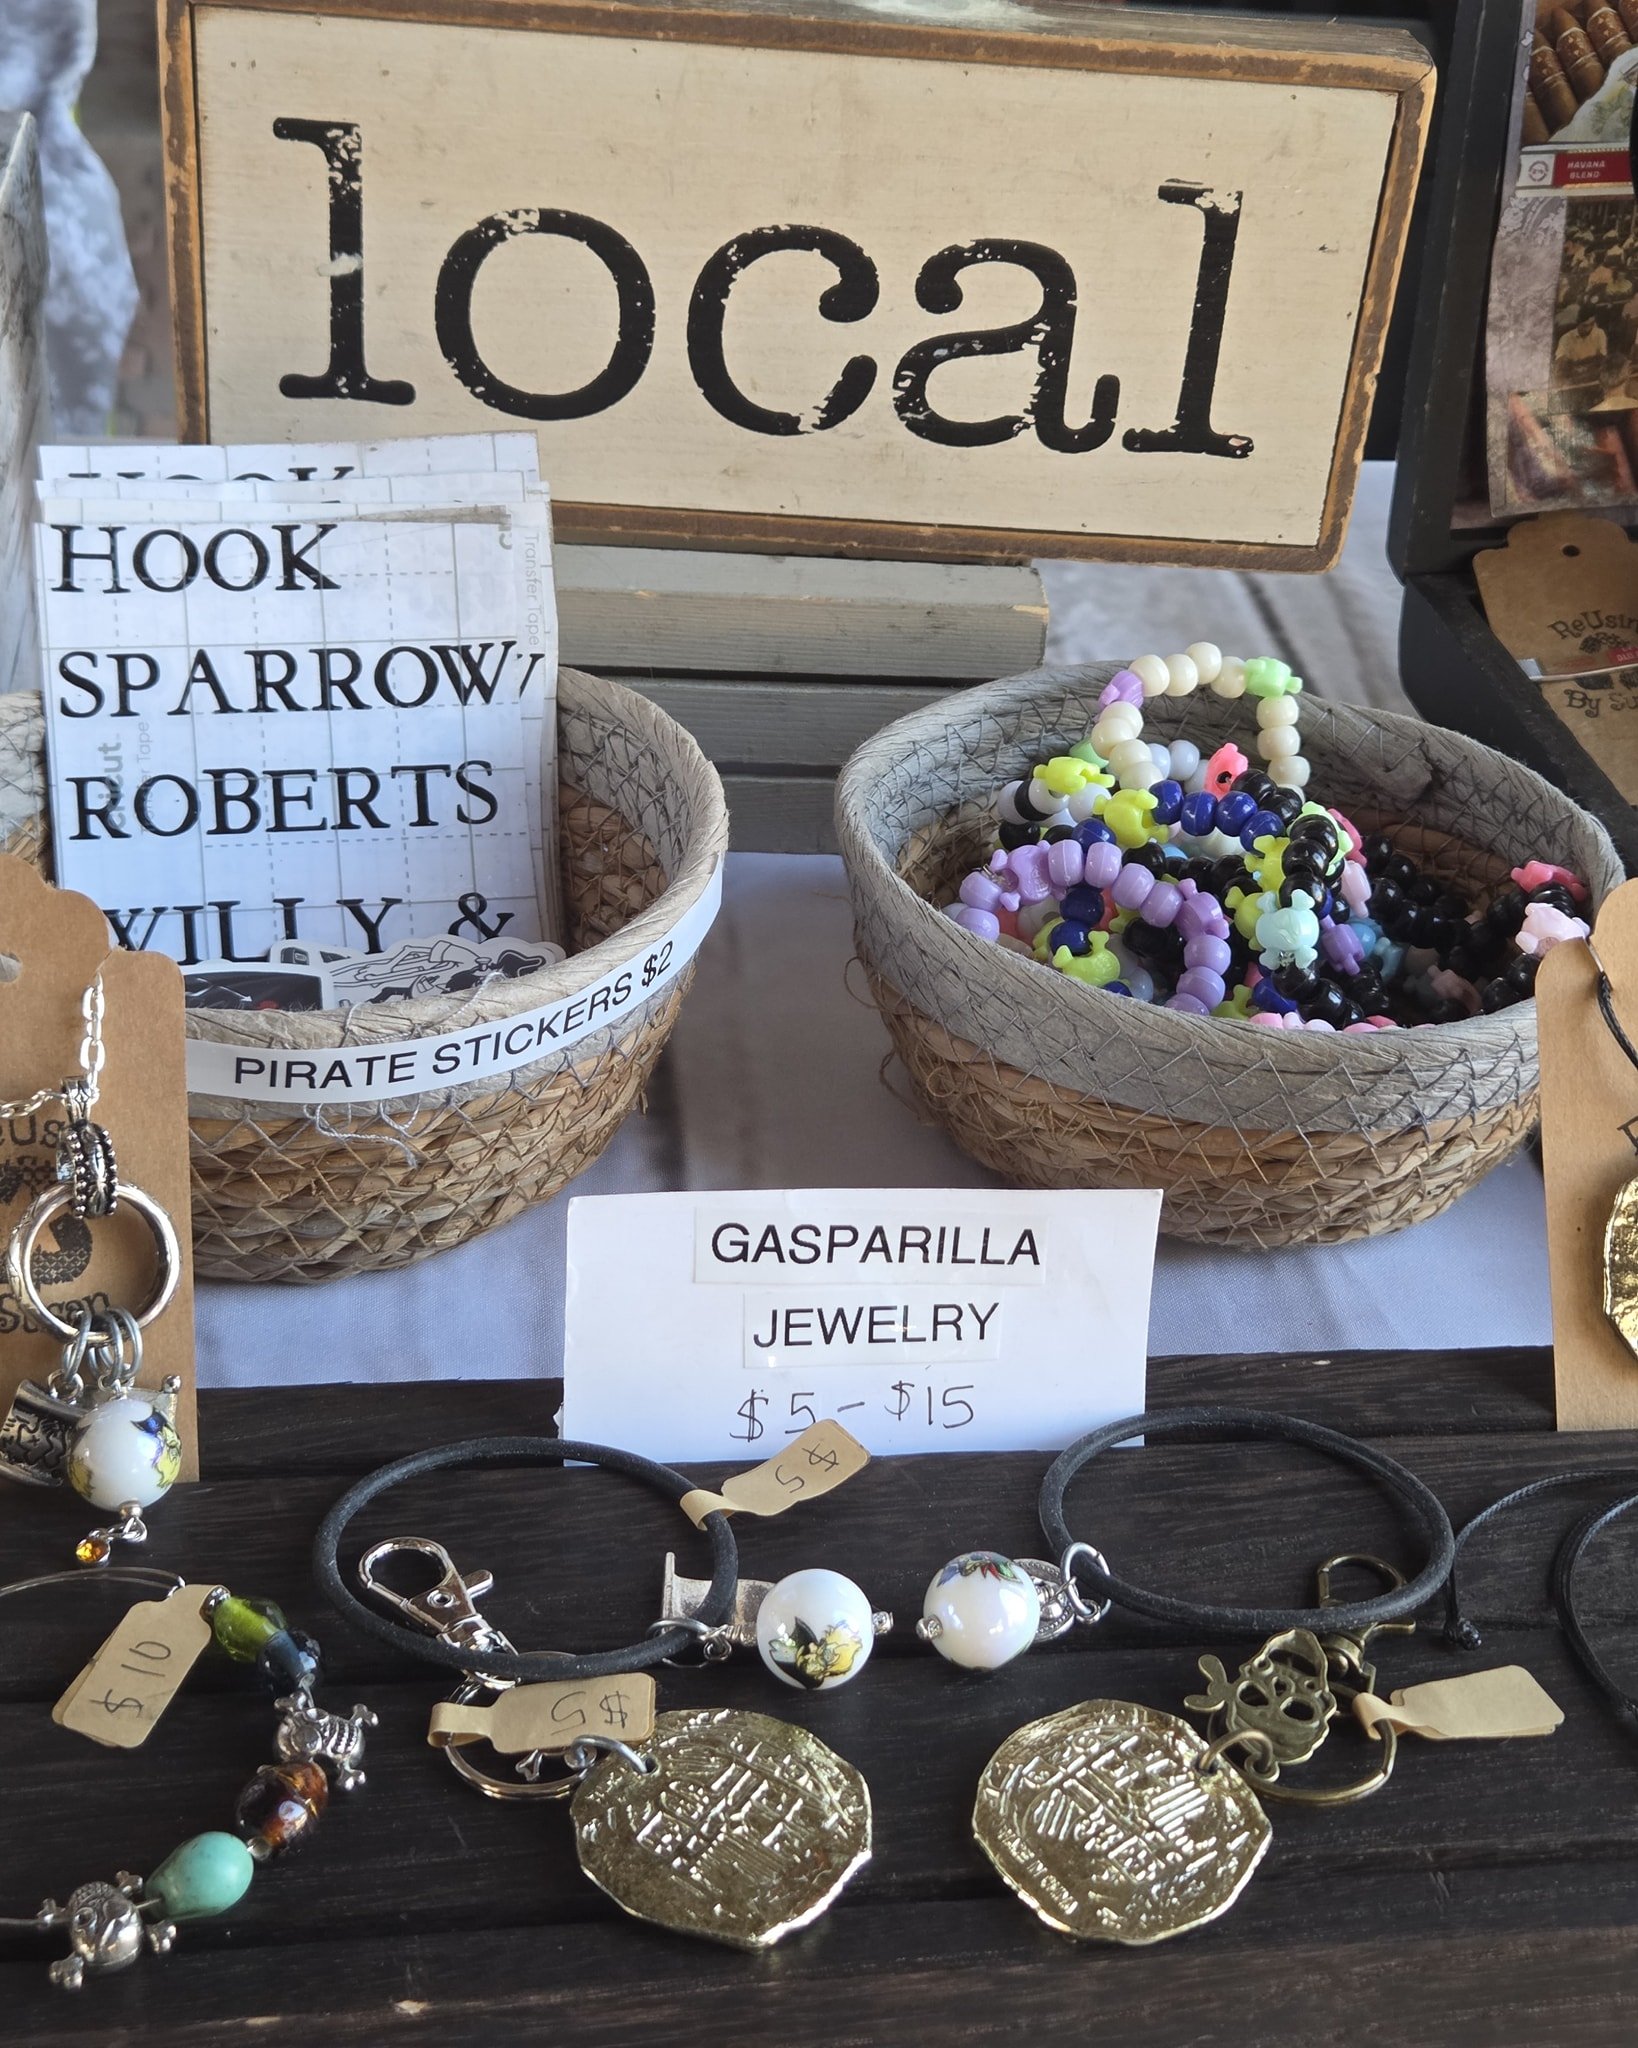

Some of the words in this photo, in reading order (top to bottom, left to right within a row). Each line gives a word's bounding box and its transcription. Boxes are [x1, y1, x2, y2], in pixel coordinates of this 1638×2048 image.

[1567, 160, 1606, 169] HAVANA
[1569, 171, 1601, 179] BLEND
[272, 117, 1255, 459] local
[50, 523, 342, 594] HOOK
[524, 533, 541, 599] Transfer
[527, 604, 541, 645] Tape
[58, 640, 517, 719] SPARROW
[1564, 688, 1601, 718] By
[136, 720, 153, 763] Tape
[65, 760, 499, 840] ROBERTS
[447, 892, 515, 943] &
[234, 1051, 418, 1090] PIRATE
[432, 971, 633, 1075] STICKERS
[641, 941, 674, 989] $2
[711, 1222, 1041, 1267] GASPARILLA
[752, 1302, 1000, 1349] JEWELRY
[884, 1380, 975, 1430] $15
[89, 1640, 172, 1720] $10
[550, 1690, 630, 1736] $5
